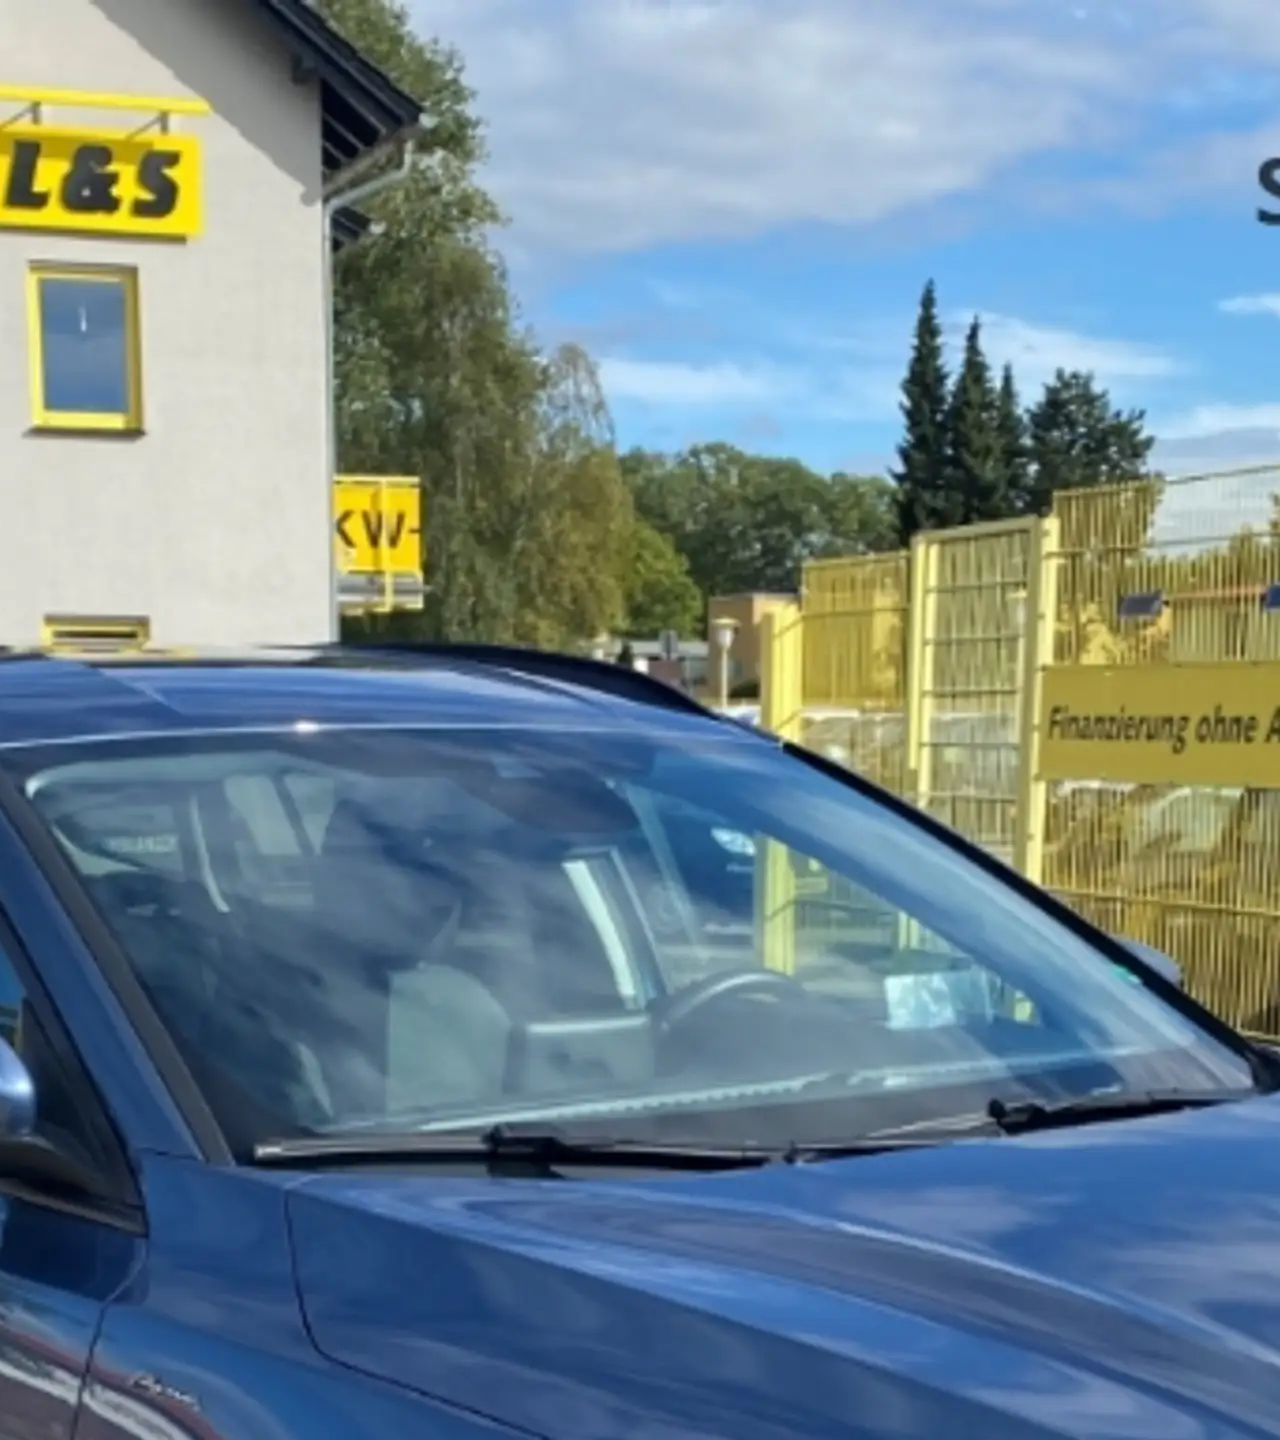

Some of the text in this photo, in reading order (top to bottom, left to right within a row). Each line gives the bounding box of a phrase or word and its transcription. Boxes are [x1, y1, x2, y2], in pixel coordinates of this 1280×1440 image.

[2, 140, 182, 218] L&S
[1047, 703, 1190, 755] Finanzierung
[1194, 703, 1258, 744] ohne
